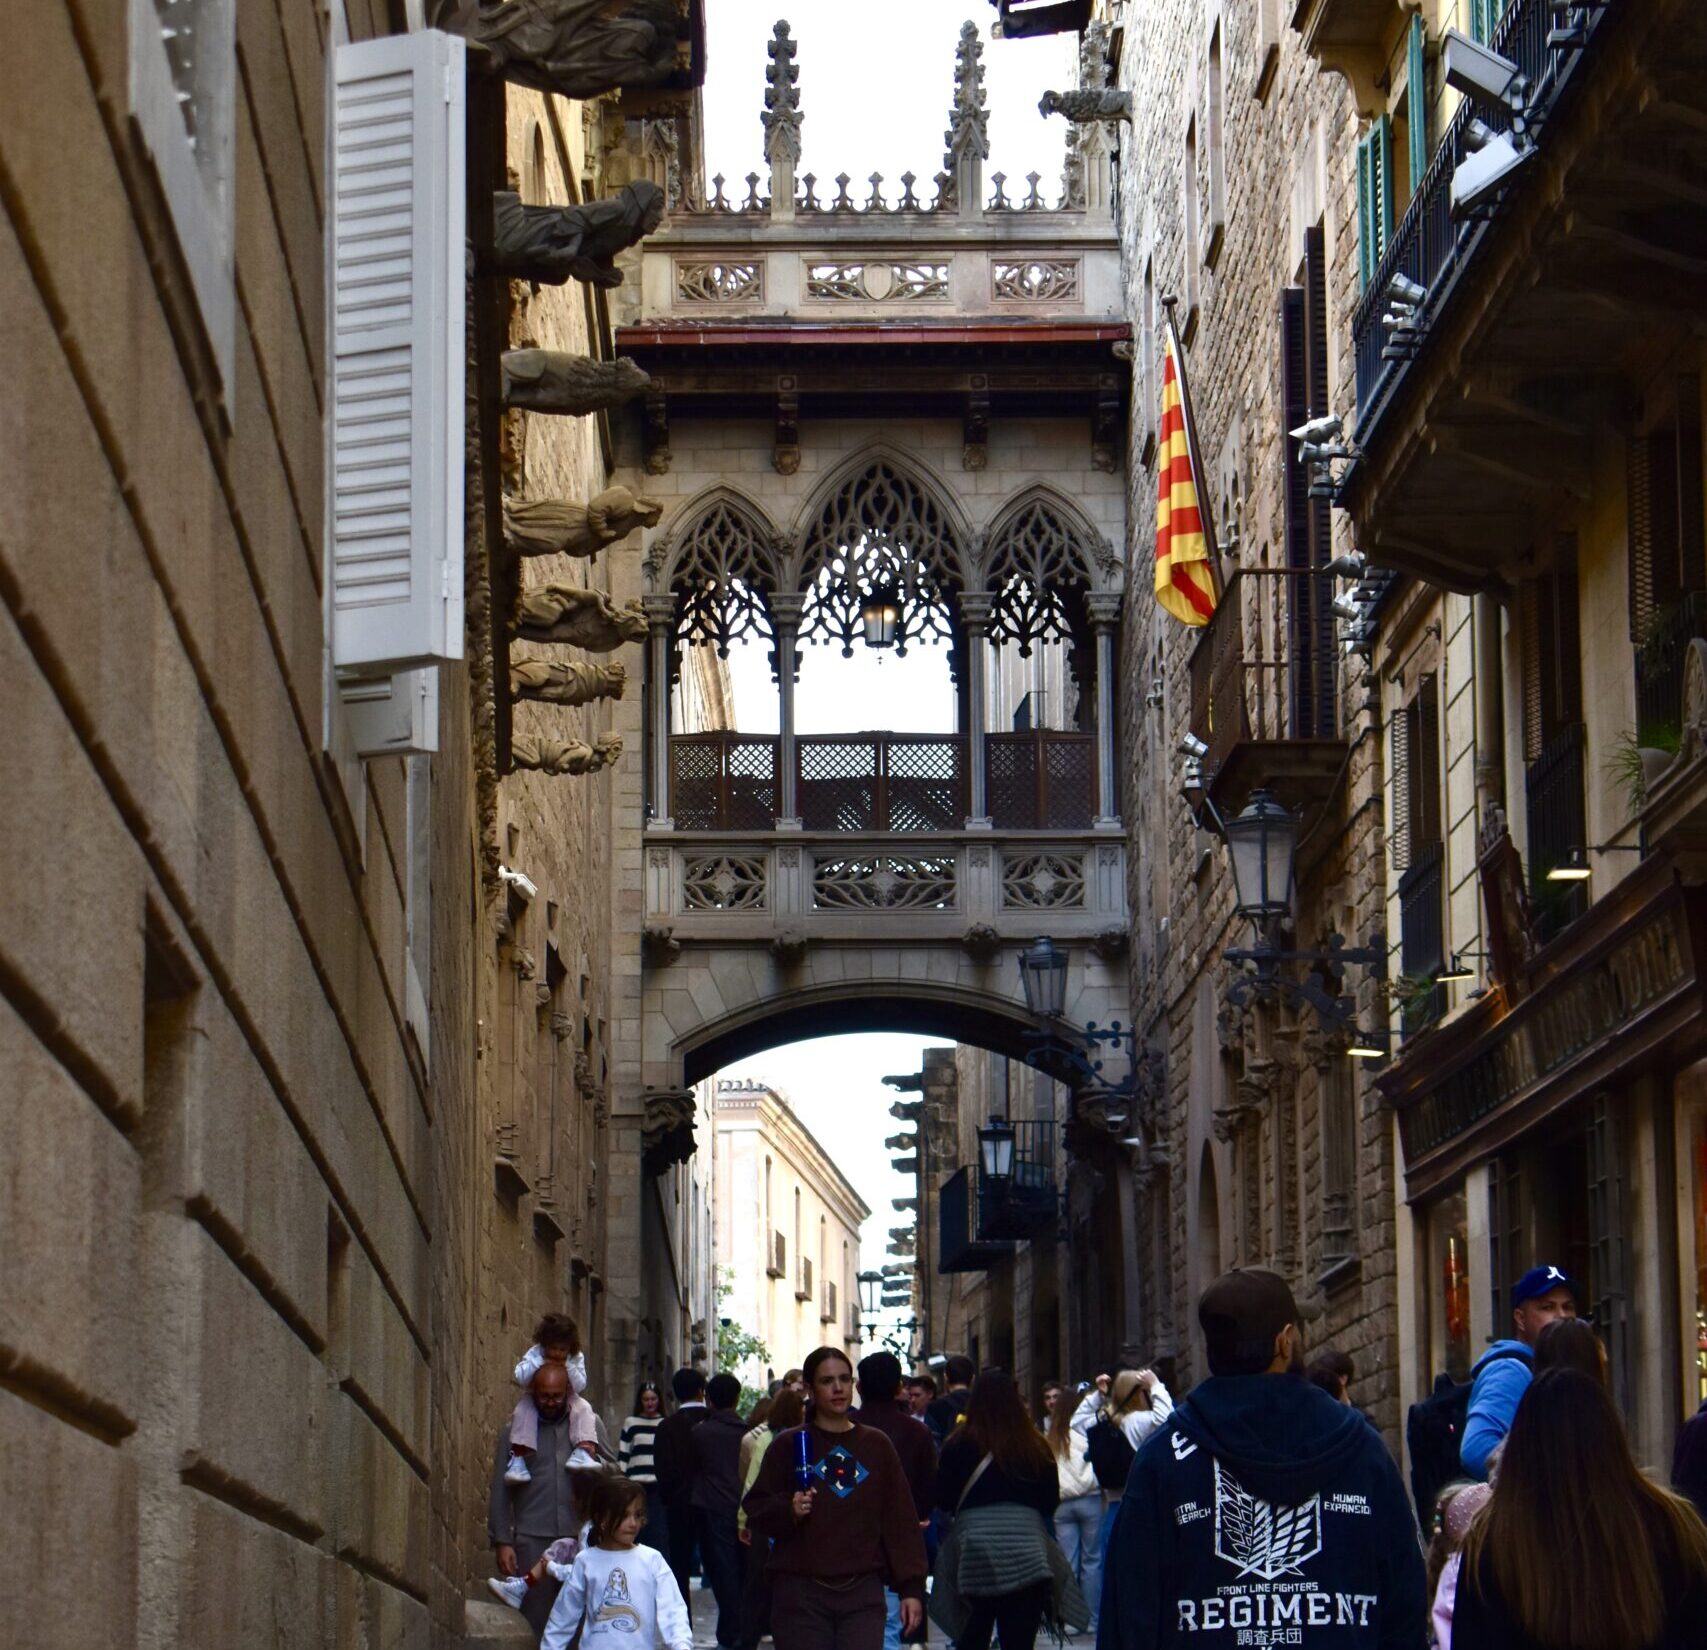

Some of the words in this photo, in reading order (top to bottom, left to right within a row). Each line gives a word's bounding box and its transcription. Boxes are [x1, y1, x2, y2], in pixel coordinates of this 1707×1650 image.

[1333, 1493, 1366, 1505] HUMAN
[1176, 1507, 1211, 1525] SEARCH
[1324, 1501, 1371, 1515] EXPANSIO
[1217, 1584, 1247, 1595] FRONT
[1249, 1583, 1270, 1593] LINE
[1273, 1582, 1318, 1592] FIGHTERS
[1177, 1592, 1377, 1631] REGIMENT
[1237, 1628, 1302, 1646] 調査兵団
